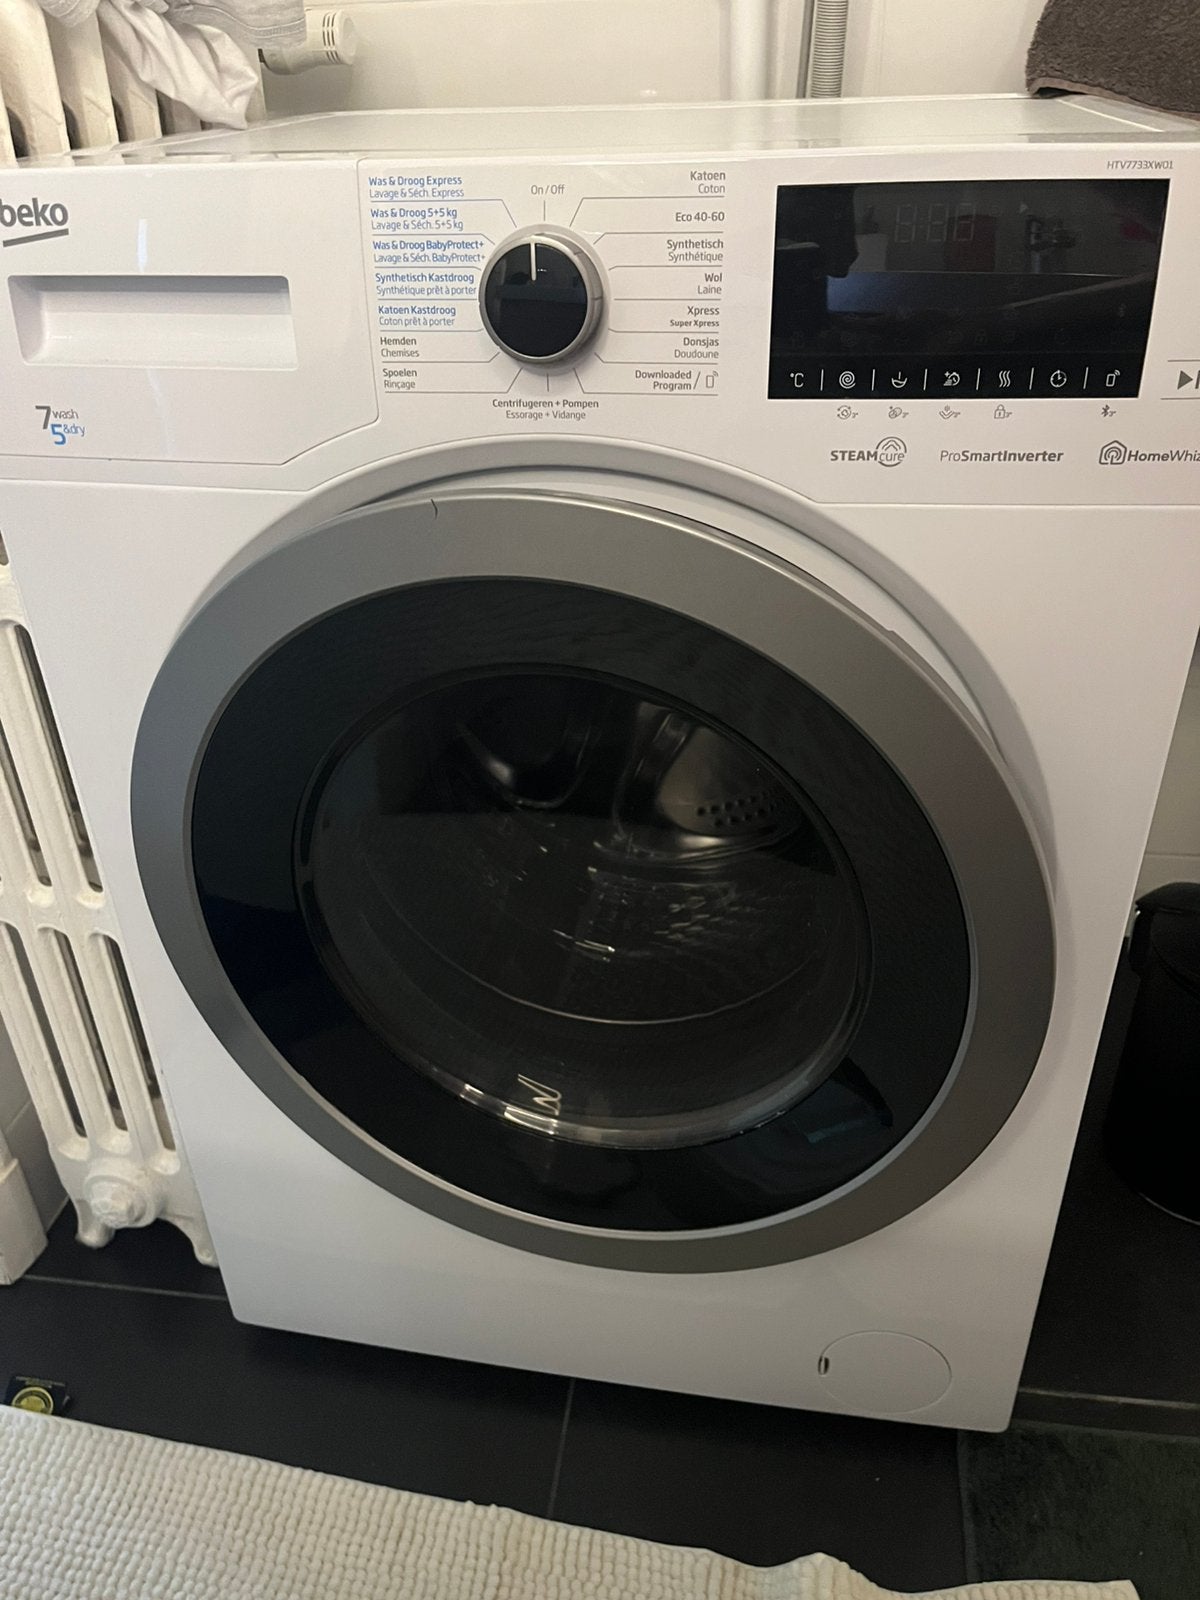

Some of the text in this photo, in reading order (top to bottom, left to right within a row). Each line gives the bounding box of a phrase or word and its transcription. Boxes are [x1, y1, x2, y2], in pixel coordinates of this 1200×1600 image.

[1106, 160, 1174, 170] HTV7733XW01
[690, 170, 726, 181] Katoen
[368, 176, 463, 187] Was & Droog Express
[370, 189, 399, 200] Lavage
[400, 188, 407, 198] &
[432, 188, 465, 199] Express
[530, 185, 544, 195] On
[551, 184, 566, 195] Off
[698, 183, 726, 194] Coton
[0, 197, 69, 227] beko
[371, 208, 458, 219] Was & Droog 5+5 kg
[675, 212, 725, 222] Eco 40-60
[372, 221, 401, 232] Lavage
[403, 220, 410, 230] &
[435, 220, 452, 230] 5+5
[453, 220, 464, 231] kg
[373, 240, 484, 252] Was & Droog BabyProtect+
[667, 239, 724, 251] Synthetisch
[374, 254, 401, 264] Lavage
[403, 253, 410, 263] &
[432, 253, 485, 264] BabyProtect+
[668, 251, 724, 264] Synthétique
[375, 273, 475, 284] Synthetisch Kastdroog
[704, 273, 722, 283] Wol
[376, 285, 477, 297] Synthétique prêt à porter
[698, 285, 722, 295] Laine
[378, 306, 457, 317] Katoen Kastdroog
[687, 306, 720, 317] Xpress
[379, 317, 455, 327] Coton prêt à porter
[670, 319, 720, 328] Super Xpress
[380, 337, 417, 346] Hemden
[683, 337, 720, 348] Donsjas
[381, 348, 420, 358] Chemises
[674, 349, 720, 359] Doudoune
[382, 368, 418, 379] Spoelen
[635, 370, 692, 380] Downloaded
[384, 379, 416, 390] Rinçage
[653, 381, 692, 392] Program
[492, 399, 554, 410] Centrifugeren
[562, 399, 600, 410] Pompen
[35, 405, 51, 430] 7
[52, 409, 79, 420] wash
[506, 410, 544, 421] Essorage
[552, 410, 587, 421] Vidange
[51, 423, 66, 446] 5
[830, 450, 906, 463] STEAMcure
[940, 450, 1065, 463] ProSmartInverter
